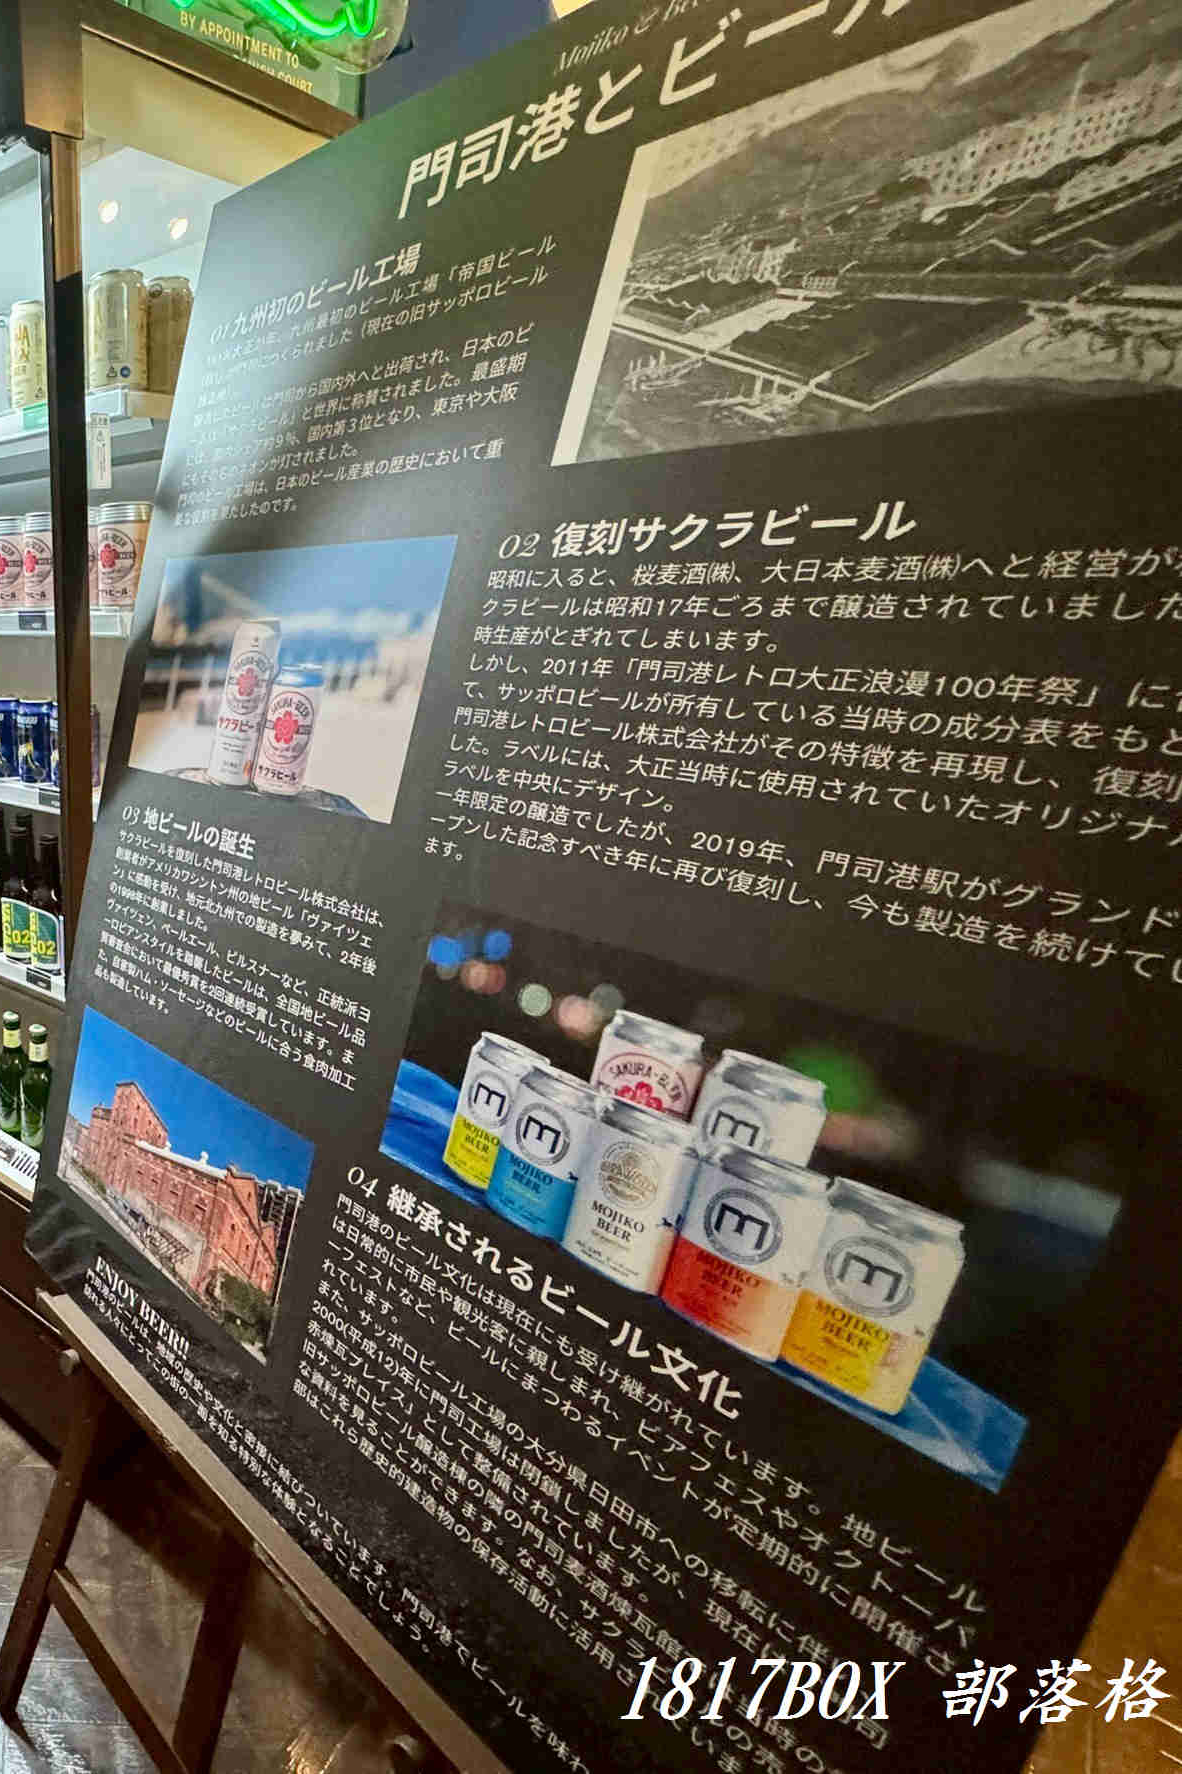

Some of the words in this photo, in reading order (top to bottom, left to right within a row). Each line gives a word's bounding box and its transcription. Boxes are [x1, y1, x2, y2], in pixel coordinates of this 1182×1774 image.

[179, 11, 196, 27] BY
[199, 18, 283, 62] APPOINTMENT
[284, 50, 300, 69] TO
[232, 243, 422, 338] 九州初のビール工場
[499, 532, 541, 560] 02
[551, 501, 917, 559] 復刻サクラビール
[473, 625, 779, 655] 時生産がとぎれてしまいます。
[468, 654, 1182, 712] しかし、2011年「門司港レトロ大正浪漫100年祭」に
[442, 760, 675, 814] ラベルを中央にデザイン。
[450, 735, 1182, 847] した。ラベルには、大正当時に使用されていたオリジナ
[143, 805, 257, 861] 地ビールの誕生
[424, 837, 465, 862] ます。
[37, 939, 57, 956] 02
[591, 1199, 645, 1234] MOJIKO
[596, 1215, 633, 1243] BEER
[95, 1255, 139, 1307] ENJOY
[139, 1299, 191, 1360] BEER!!
[321, 1257, 401, 1325] れています。
[347, 1166, 379, 1199] 04
[386, 1183, 743, 1420] 継承されるビール文化
